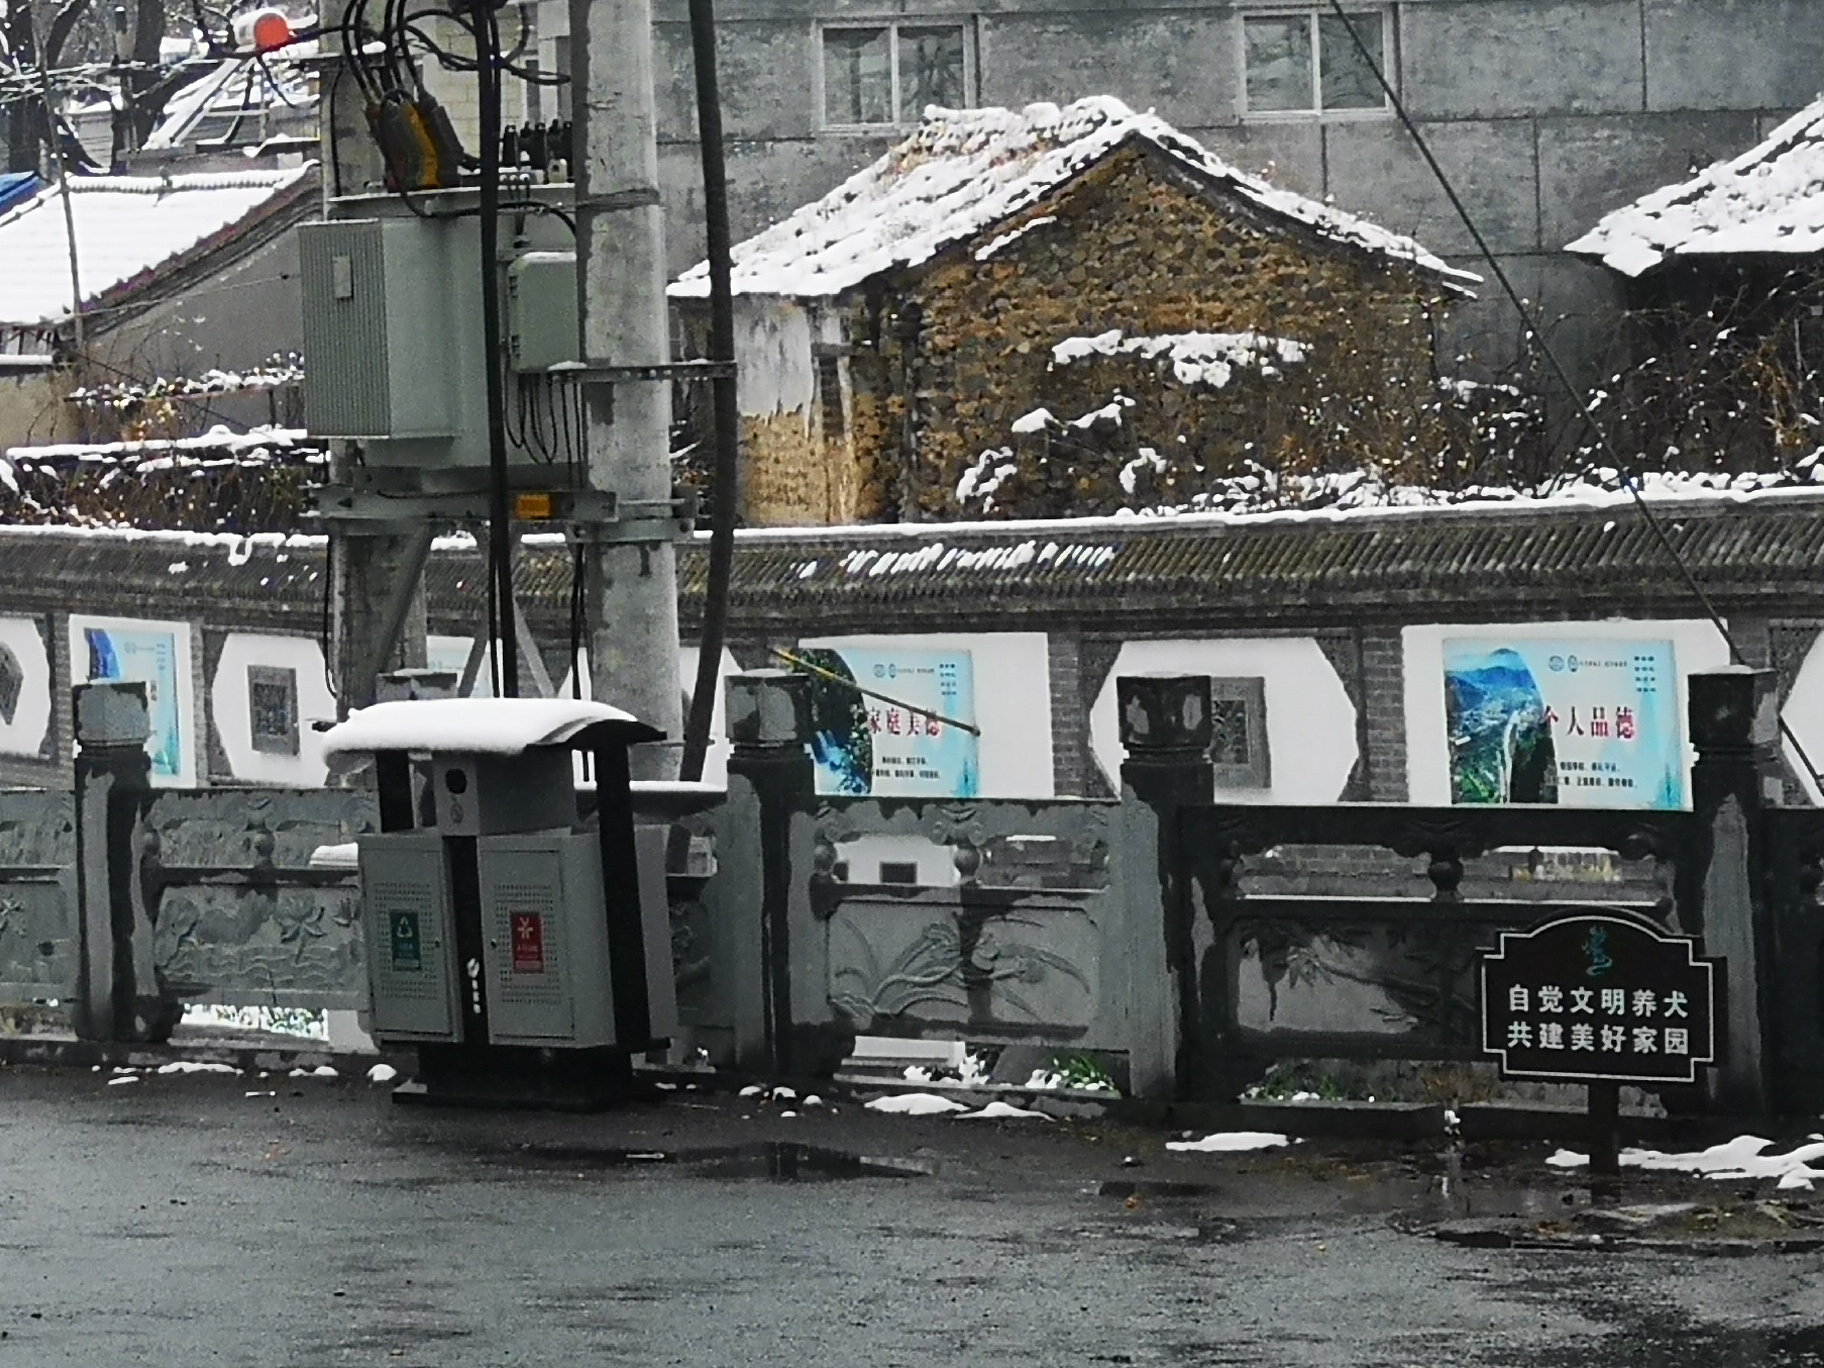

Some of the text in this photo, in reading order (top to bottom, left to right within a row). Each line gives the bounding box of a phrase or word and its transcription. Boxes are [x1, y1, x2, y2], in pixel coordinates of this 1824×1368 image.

[1540, 705, 1635, 739] 个人品德
[1508, 984, 1689, 1018] 自觉文明养犬
[1507, 1022, 1689, 1056] 共建美好家园
